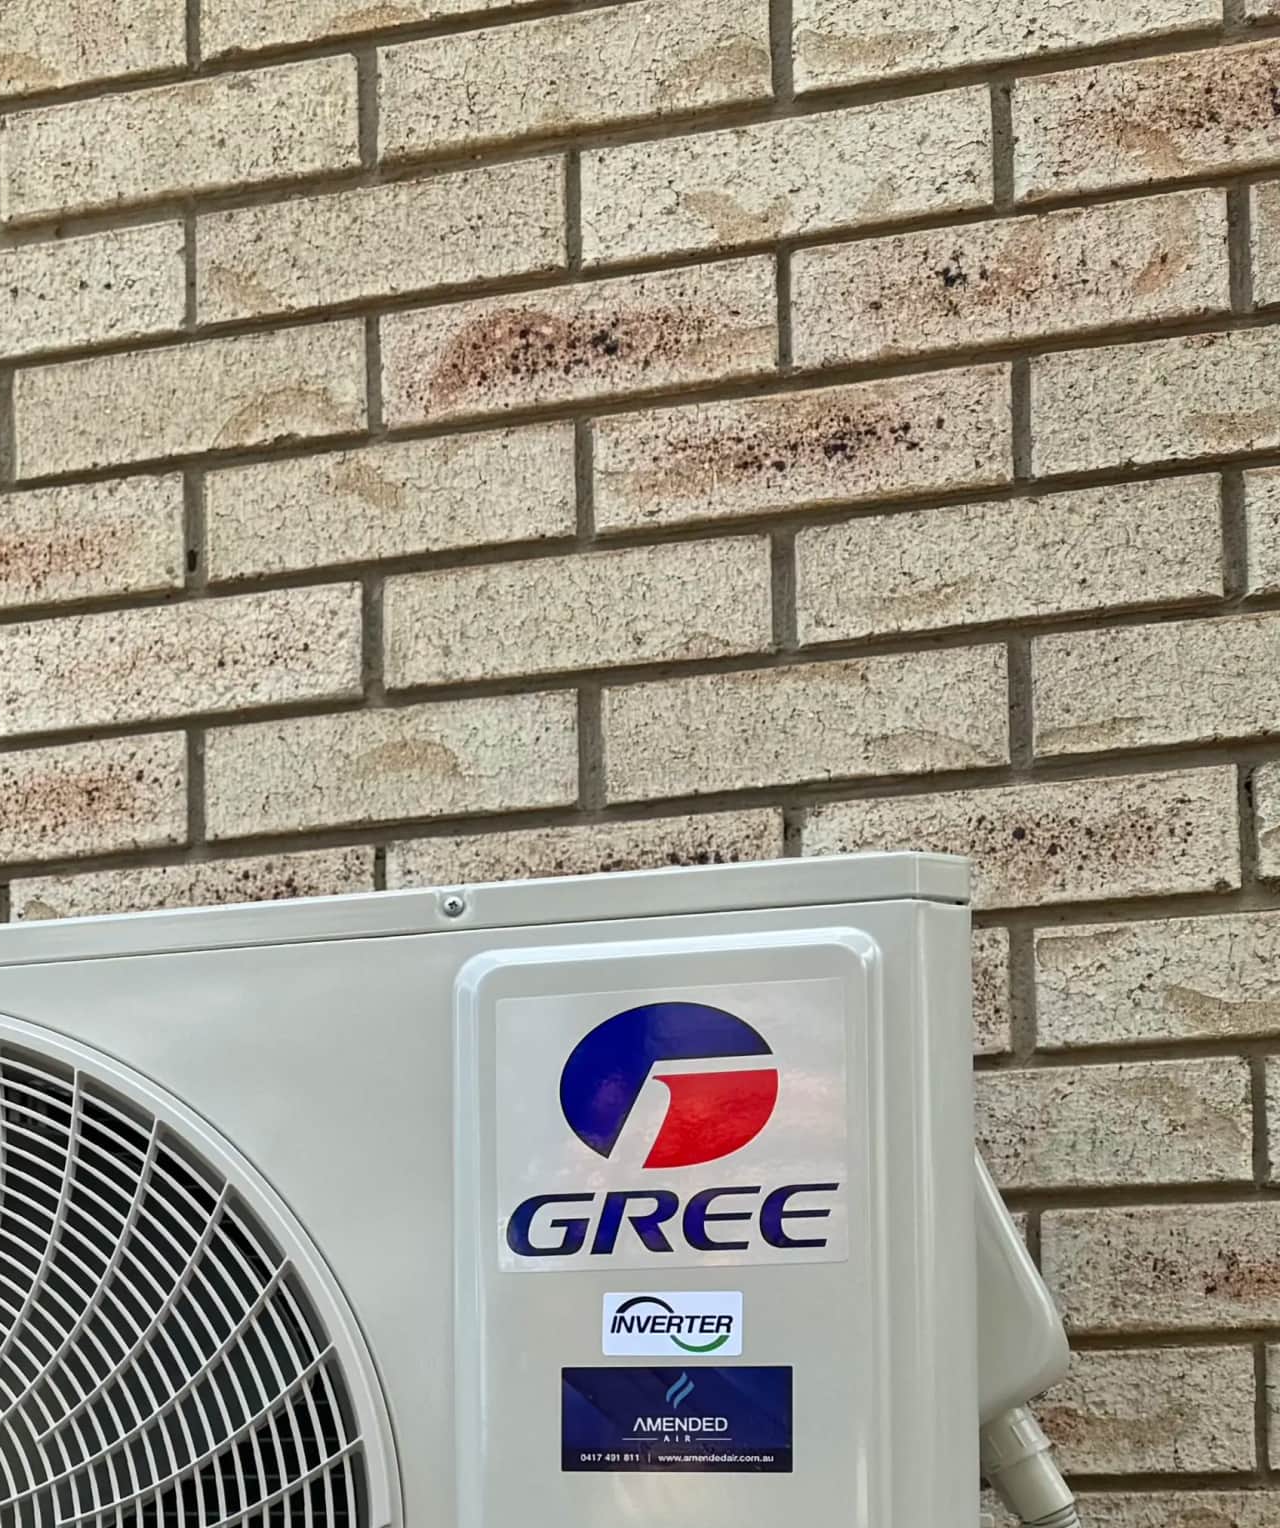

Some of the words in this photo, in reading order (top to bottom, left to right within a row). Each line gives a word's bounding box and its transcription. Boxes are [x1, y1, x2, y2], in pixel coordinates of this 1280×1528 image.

[506, 1183, 839, 1257] GREE
[610, 1315, 734, 1334] INVERTER
[633, 1417, 728, 1431] AMENDED
